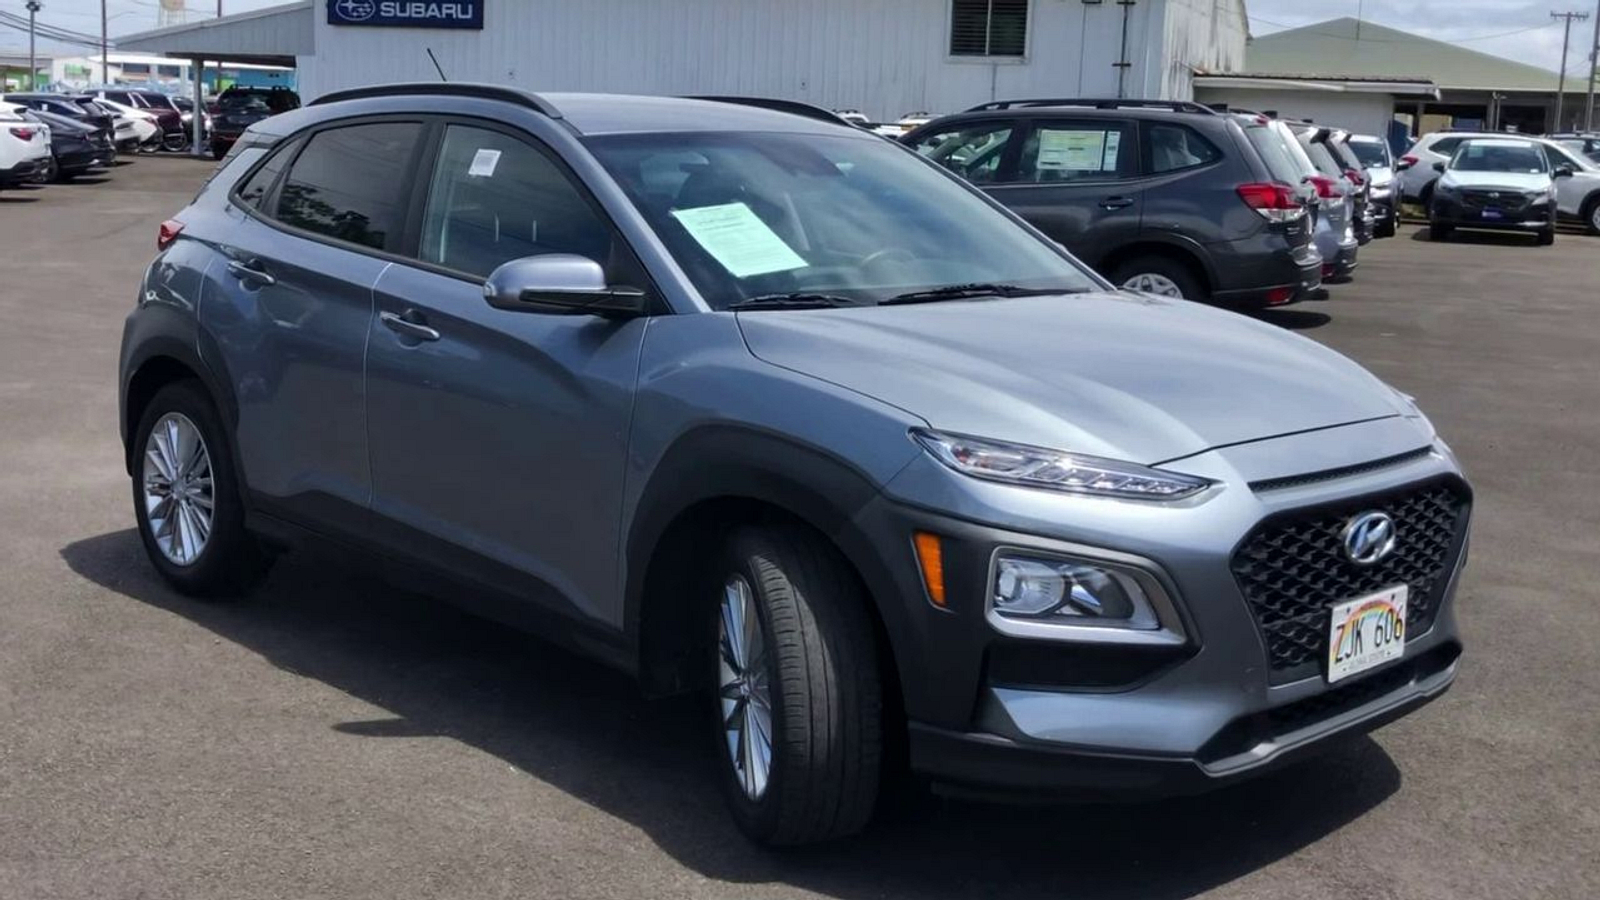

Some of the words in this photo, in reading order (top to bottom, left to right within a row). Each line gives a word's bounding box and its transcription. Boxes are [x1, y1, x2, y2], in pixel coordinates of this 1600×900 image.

[380, 2, 473, 19] SUBARU
[1334, 616, 1365, 665] ZJK
[1374, 604, 1404, 648] 606
